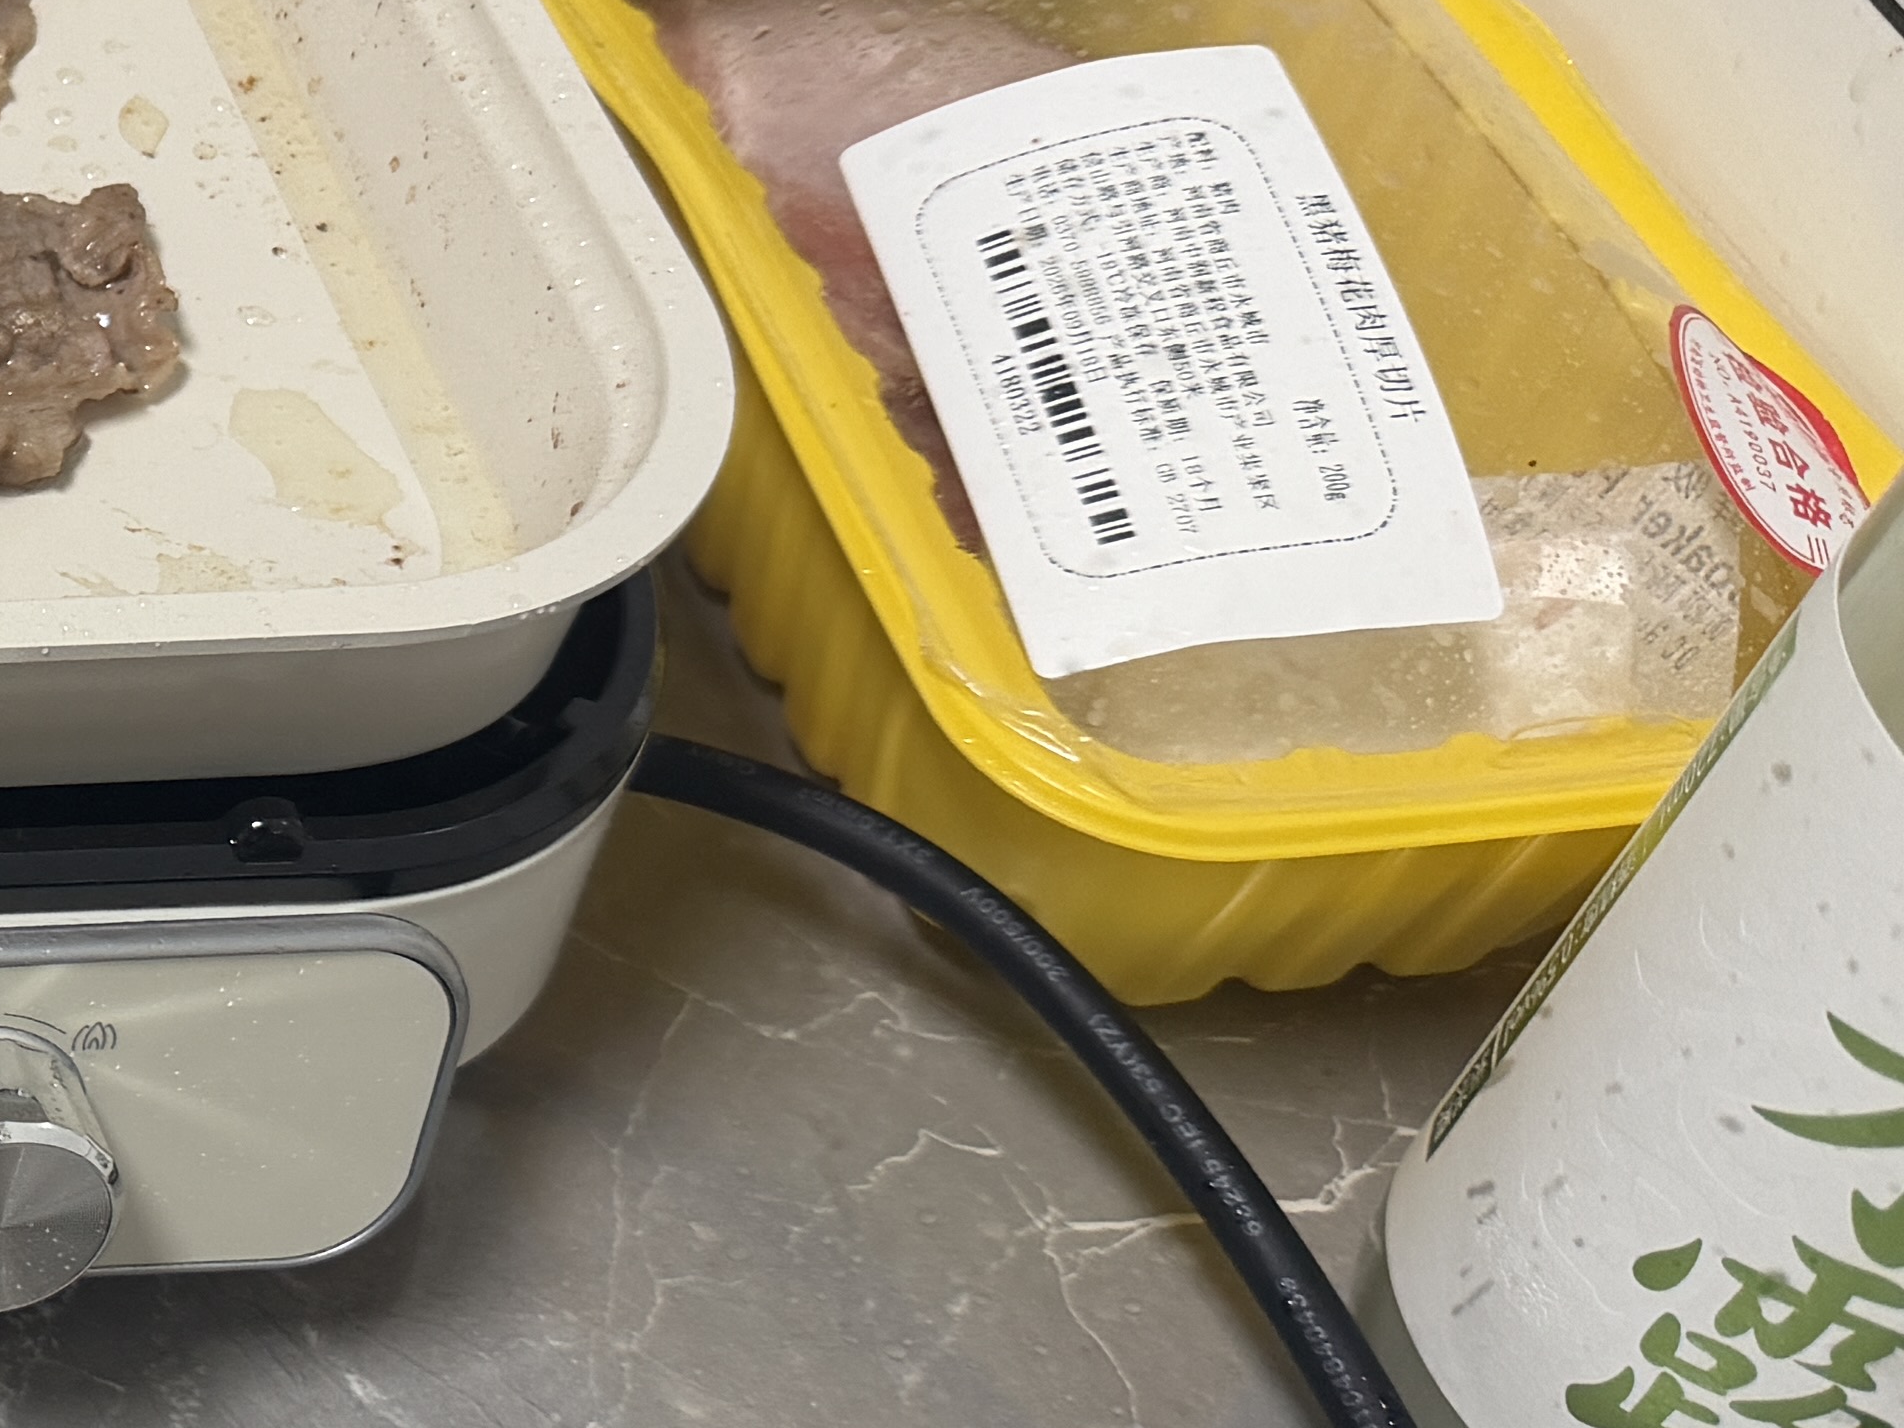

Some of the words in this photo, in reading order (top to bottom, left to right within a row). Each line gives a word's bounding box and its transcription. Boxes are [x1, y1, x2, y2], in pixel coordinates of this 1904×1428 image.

[1295, 194, 1426, 423] 黑猪梅花肉厚切片
[986, 351, 1045, 436] 4180322
